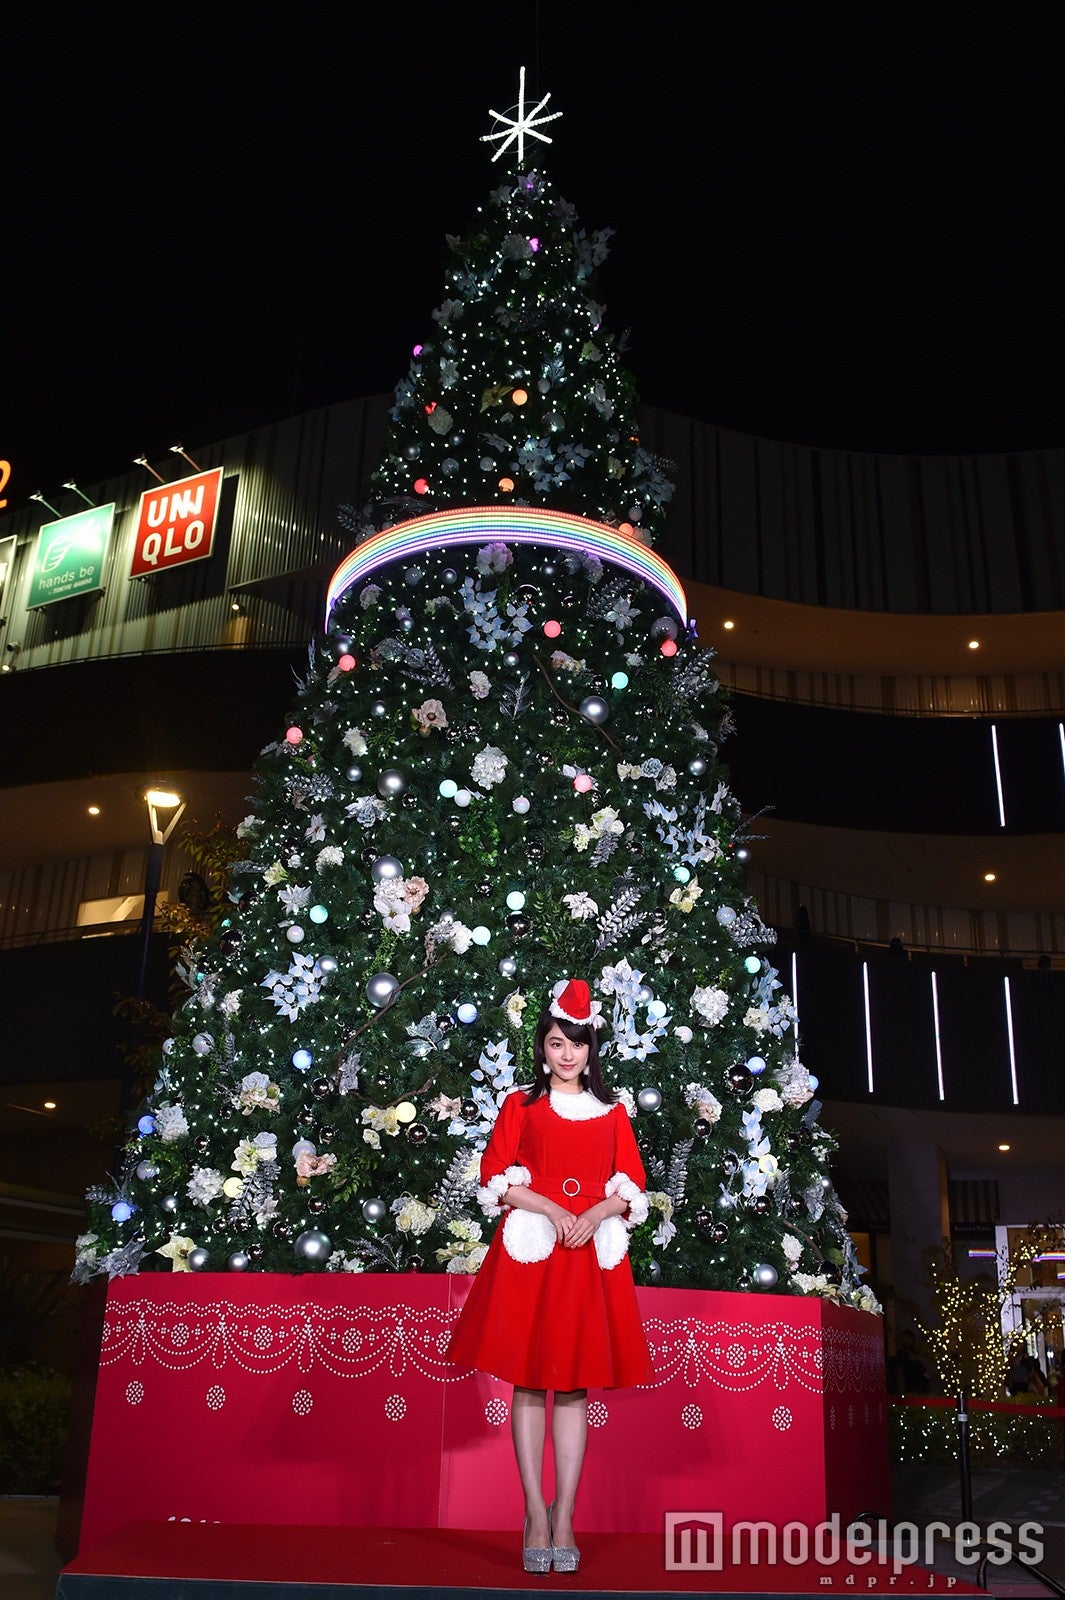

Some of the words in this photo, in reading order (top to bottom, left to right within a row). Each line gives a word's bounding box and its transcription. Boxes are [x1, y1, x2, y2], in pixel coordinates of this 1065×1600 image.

[147, 485, 205, 528] UNI
[142, 520, 204, 565] QLO
[38, 571, 75, 590] hands
[79, 565, 94, 578] be
